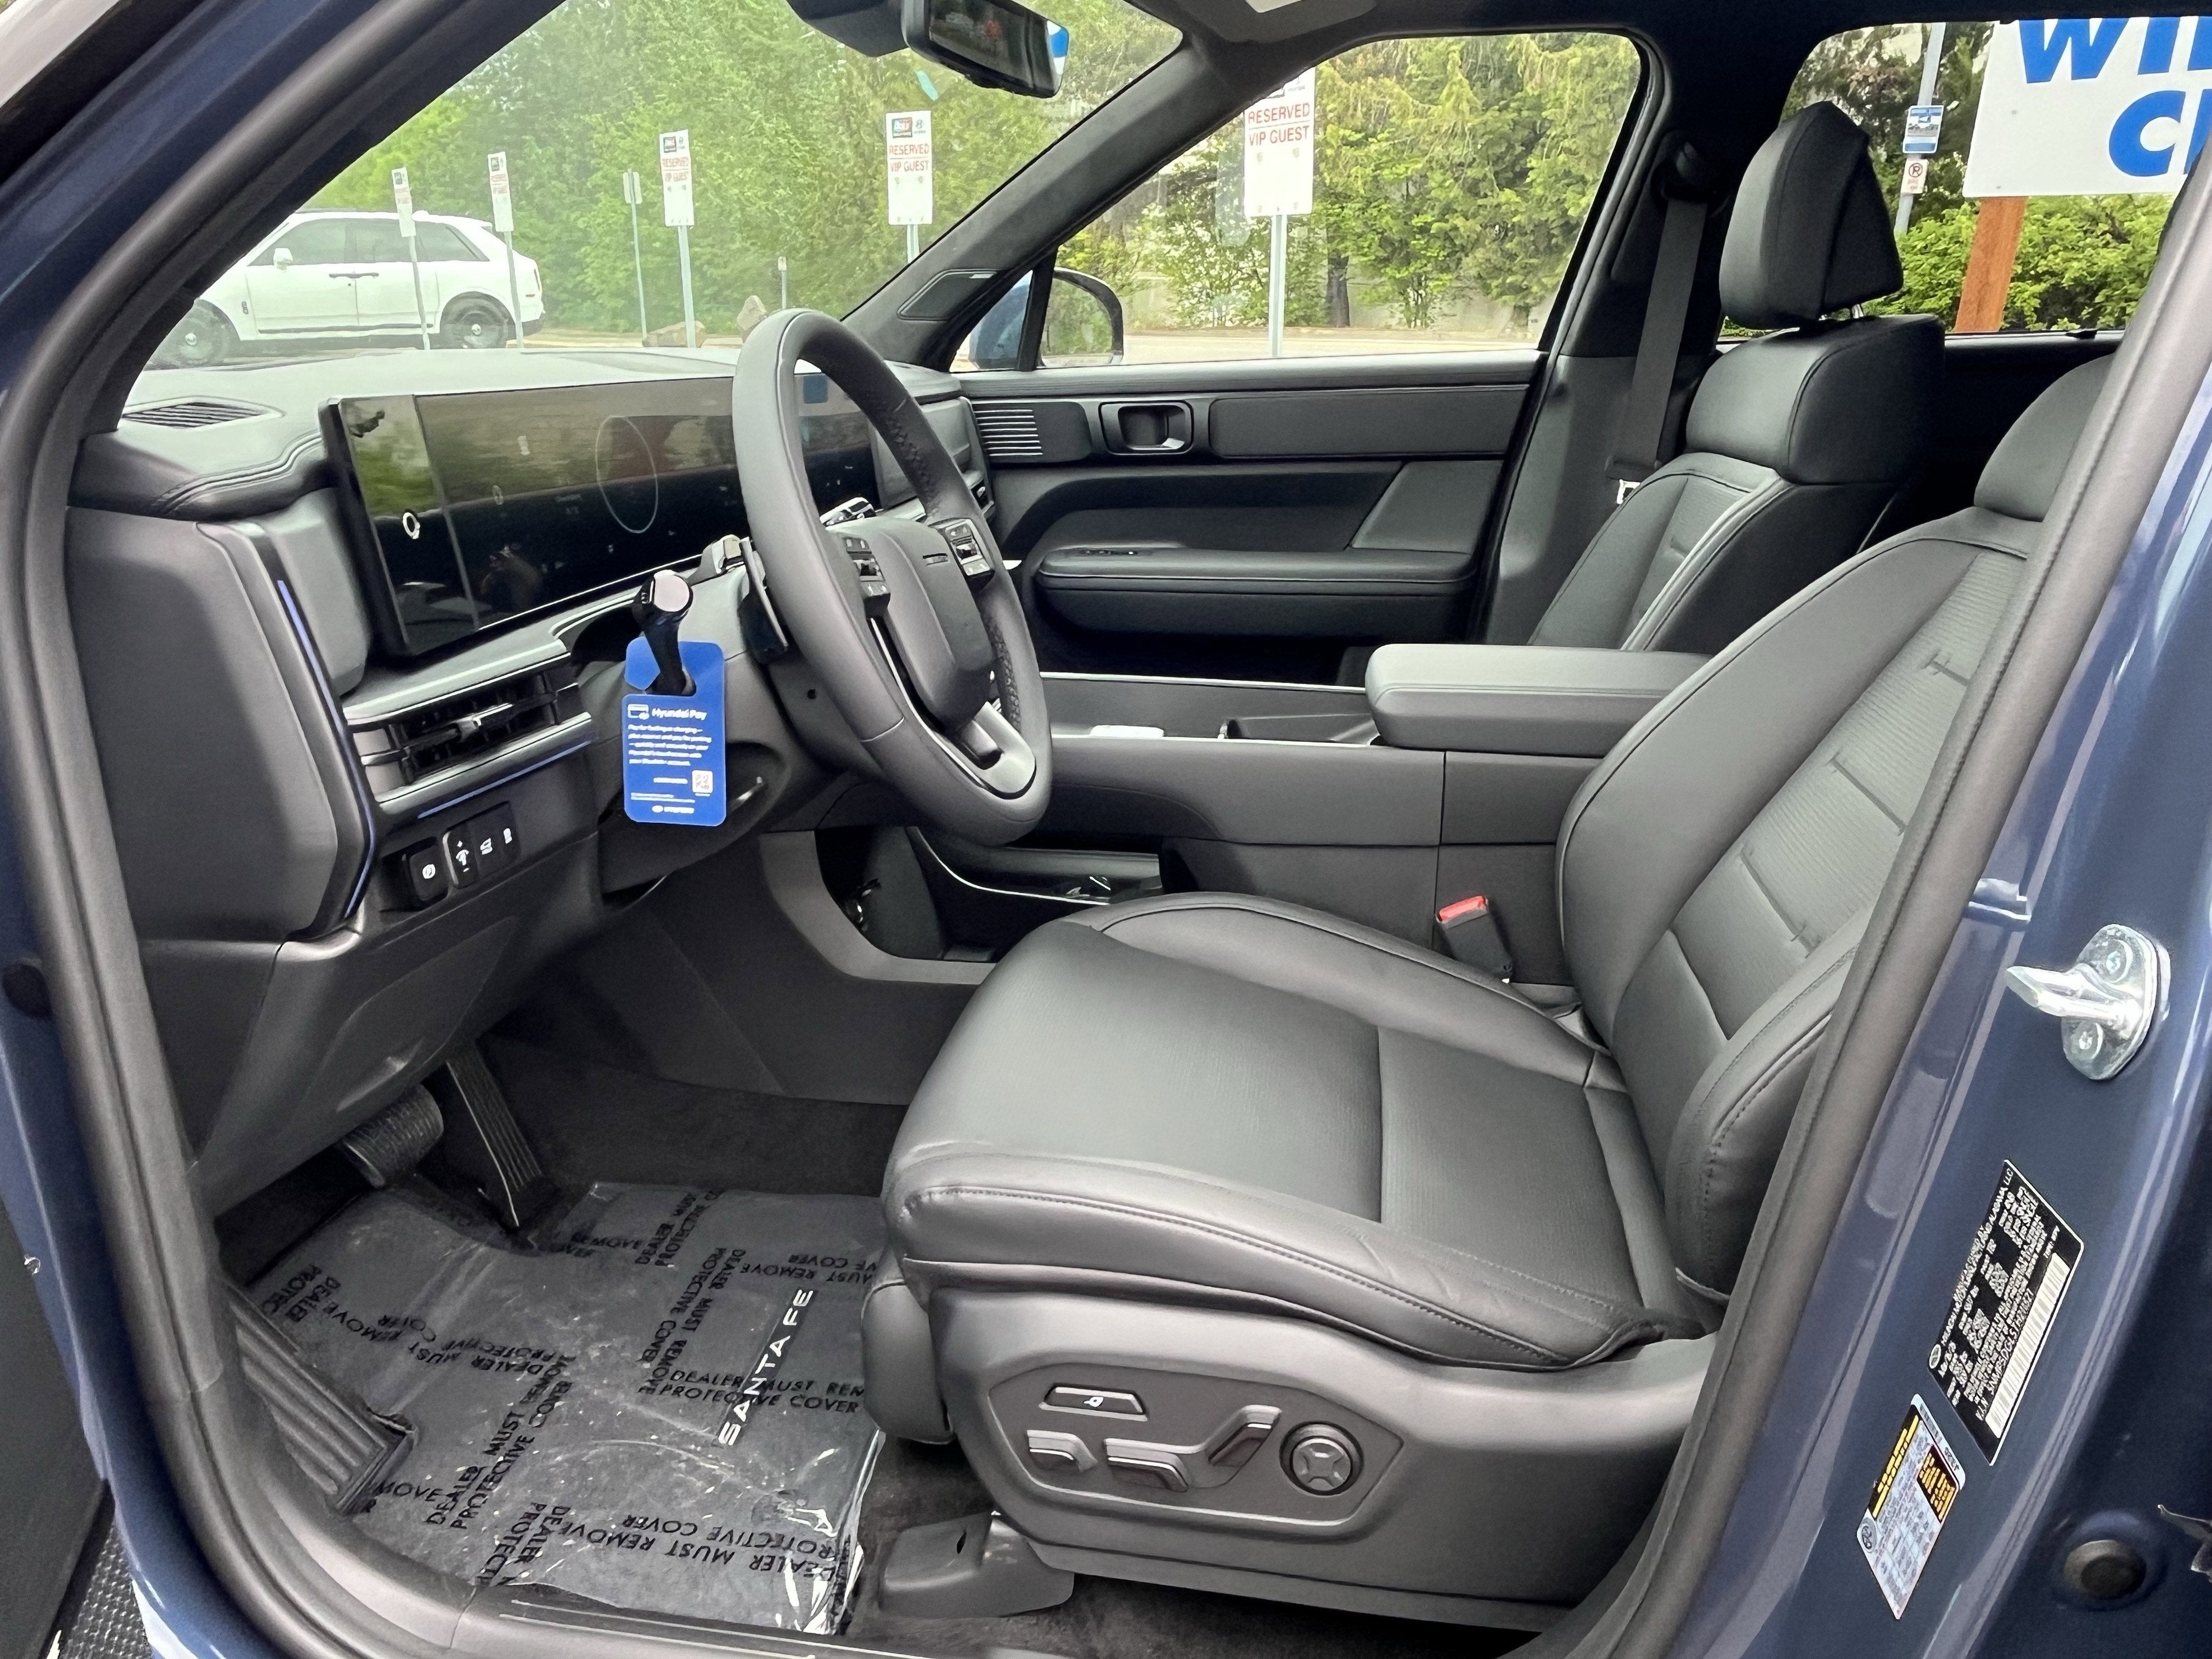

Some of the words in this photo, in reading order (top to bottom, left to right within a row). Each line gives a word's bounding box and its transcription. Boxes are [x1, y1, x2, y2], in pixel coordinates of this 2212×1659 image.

[1248, 103, 1310, 125] RESERVED
[1249, 132, 1266, 146] VIP
[1270, 125, 1310, 144] GUEST
[889, 144, 929, 155] RESERVED
[891, 162, 901, 172] VIP
[904, 160, 929, 172] GUEST
[2004, 1168, 2013, 1185] LLC
[718, 1334, 792, 1447] SANTA
[782, 1289, 814, 1327] FE
[789, 1393, 860, 1413] COVER
[558, 1522, 656, 1551] REMOVE
[622, 1514, 698, 1537] COVER
[664, 1539, 735, 1566] MUST
[706, 1525, 835, 1560] ROTECTIVE
